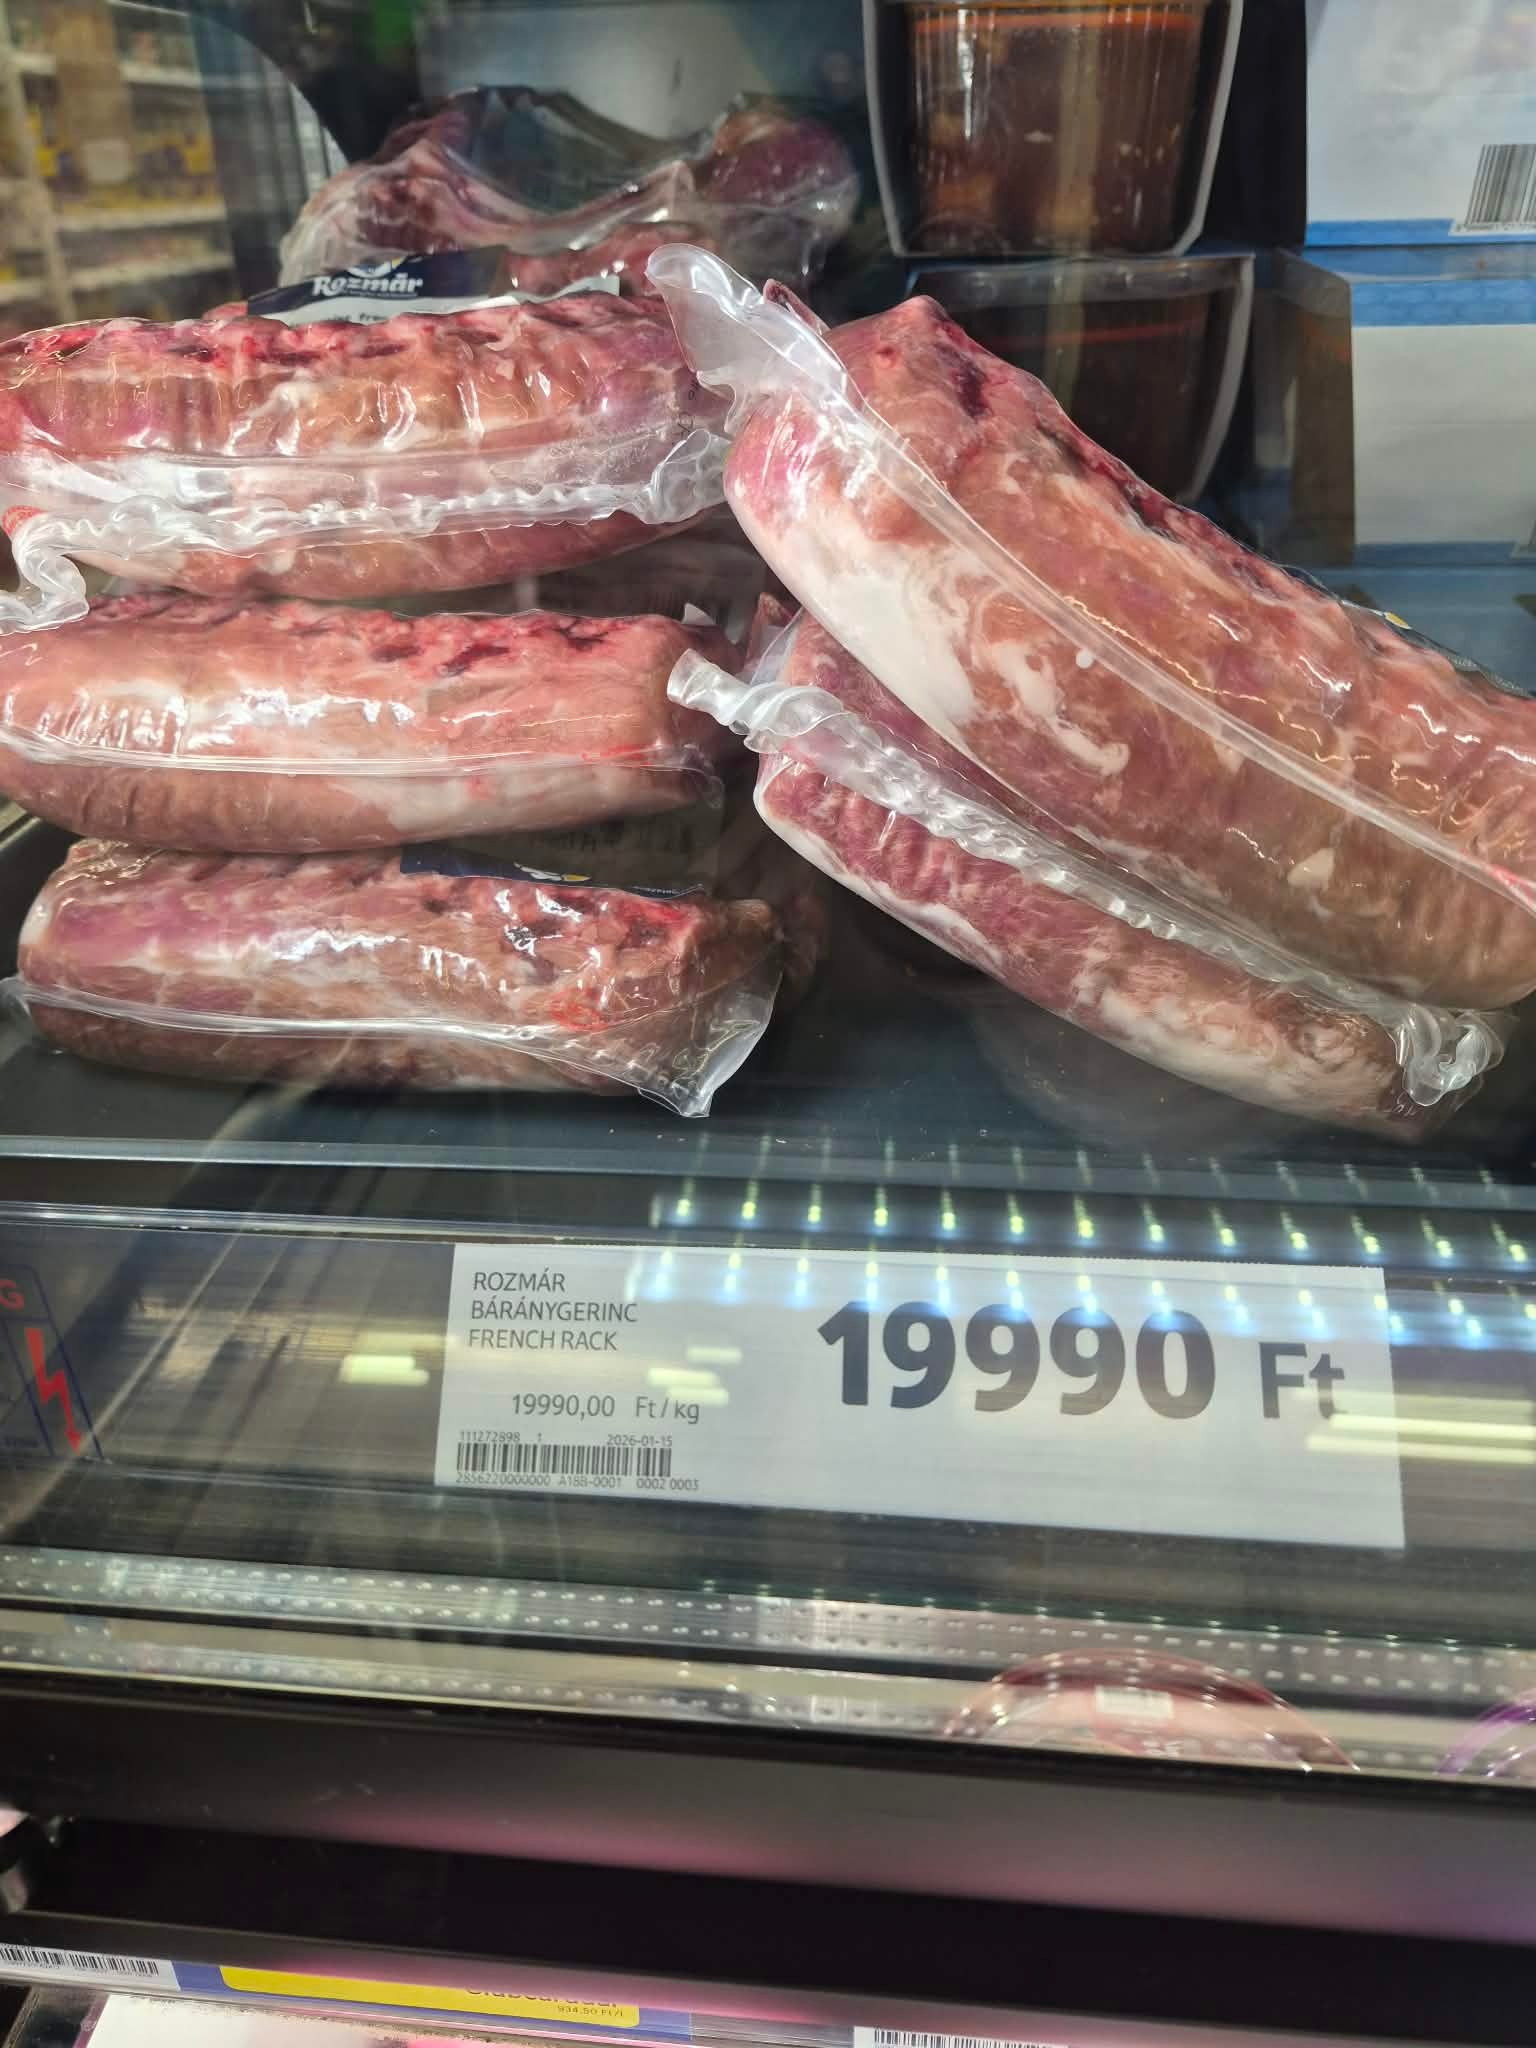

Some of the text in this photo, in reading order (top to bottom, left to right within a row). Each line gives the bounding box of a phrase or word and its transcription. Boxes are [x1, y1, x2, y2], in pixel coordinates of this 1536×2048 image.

[473, 1268, 566, 1292] ROZMÁR
[471, 1296, 638, 1322] BÁRÁNYGERINC
[469, 1328, 618, 1351] FRENCH RACK
[817, 1300, 1216, 1419] 19990
[1258, 1342, 1345, 1419] Ft
[512, 1393, 615, 1420] 19990,00
[607, 1434, 673, 1447] 2026-01-15
